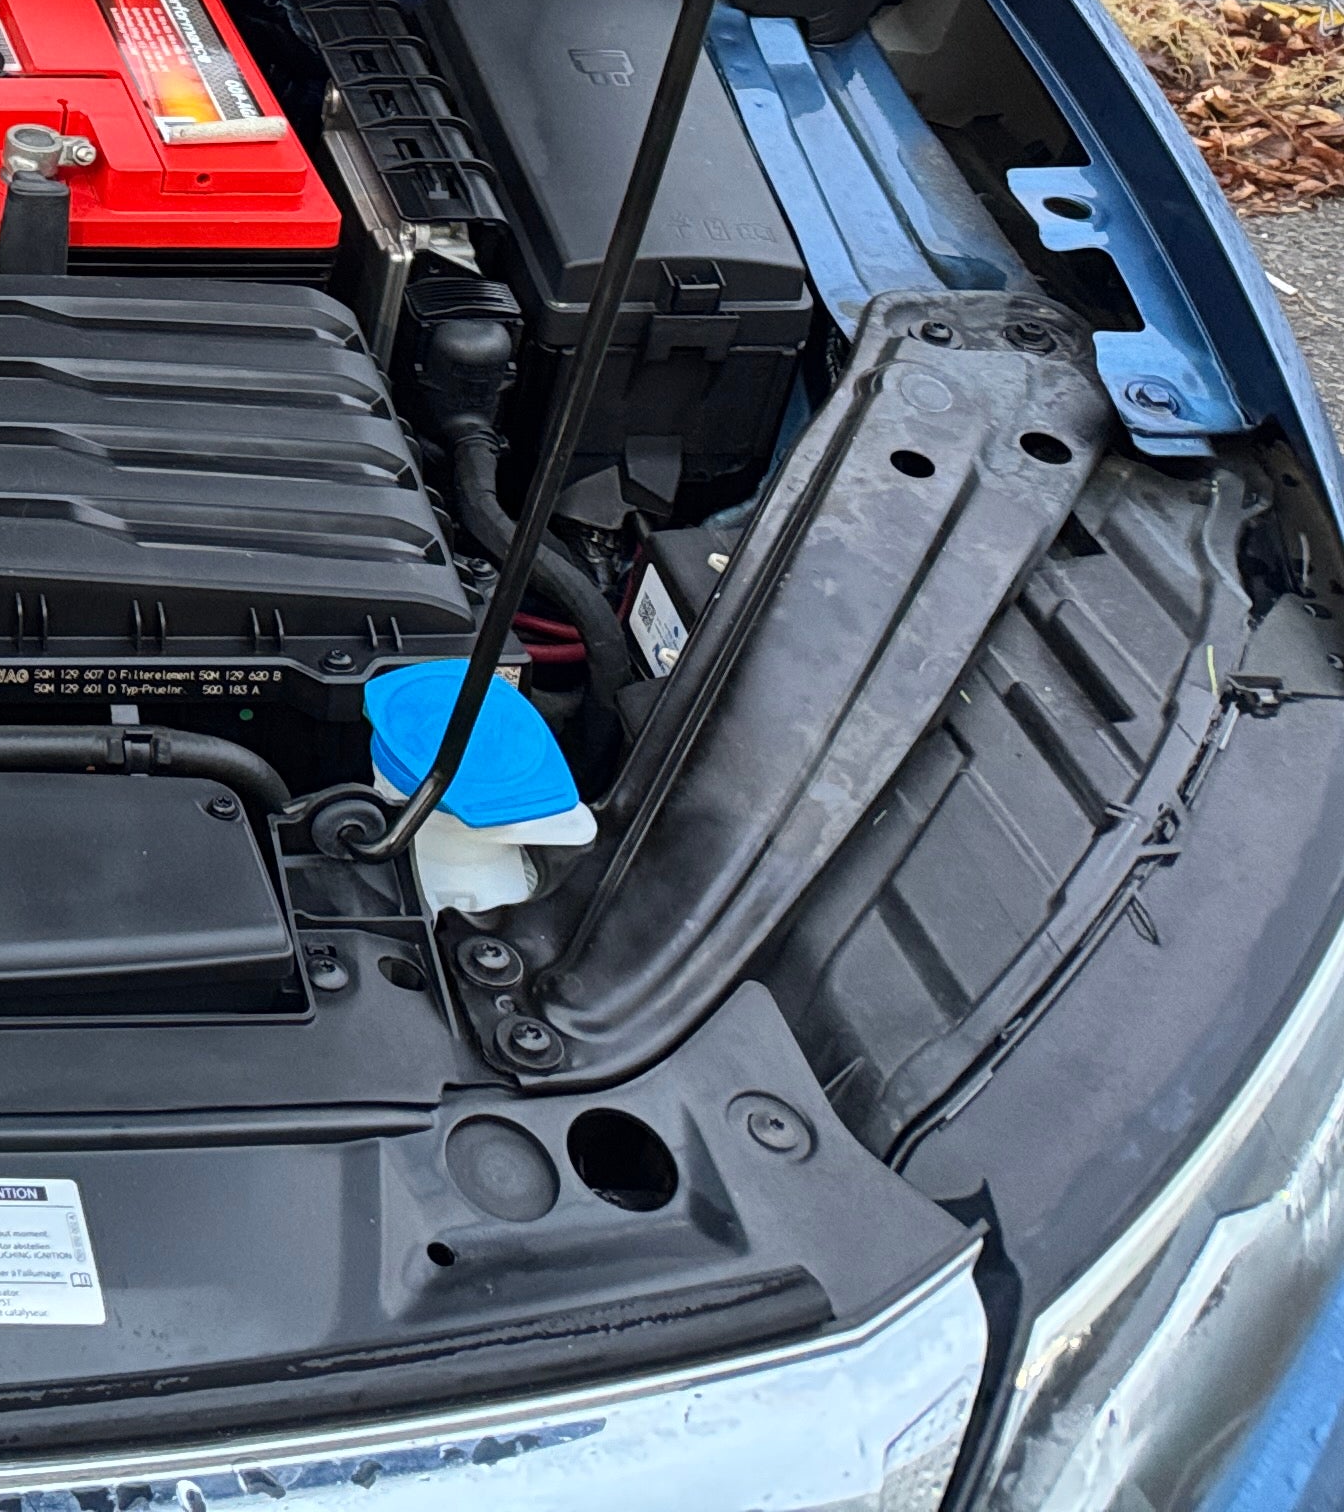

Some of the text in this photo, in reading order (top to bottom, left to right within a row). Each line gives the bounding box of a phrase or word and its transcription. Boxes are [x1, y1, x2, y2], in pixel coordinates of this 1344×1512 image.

[60, 670, 79, 680] 129
[84, 670, 104, 680] 607
[108, 671, 116, 680] D
[226, 671, 243, 681] 129
[60, 684, 79, 694] 129
[84, 684, 102, 694] 601
[108, 685, 116, 694] D
[252, 686, 260, 694] A
